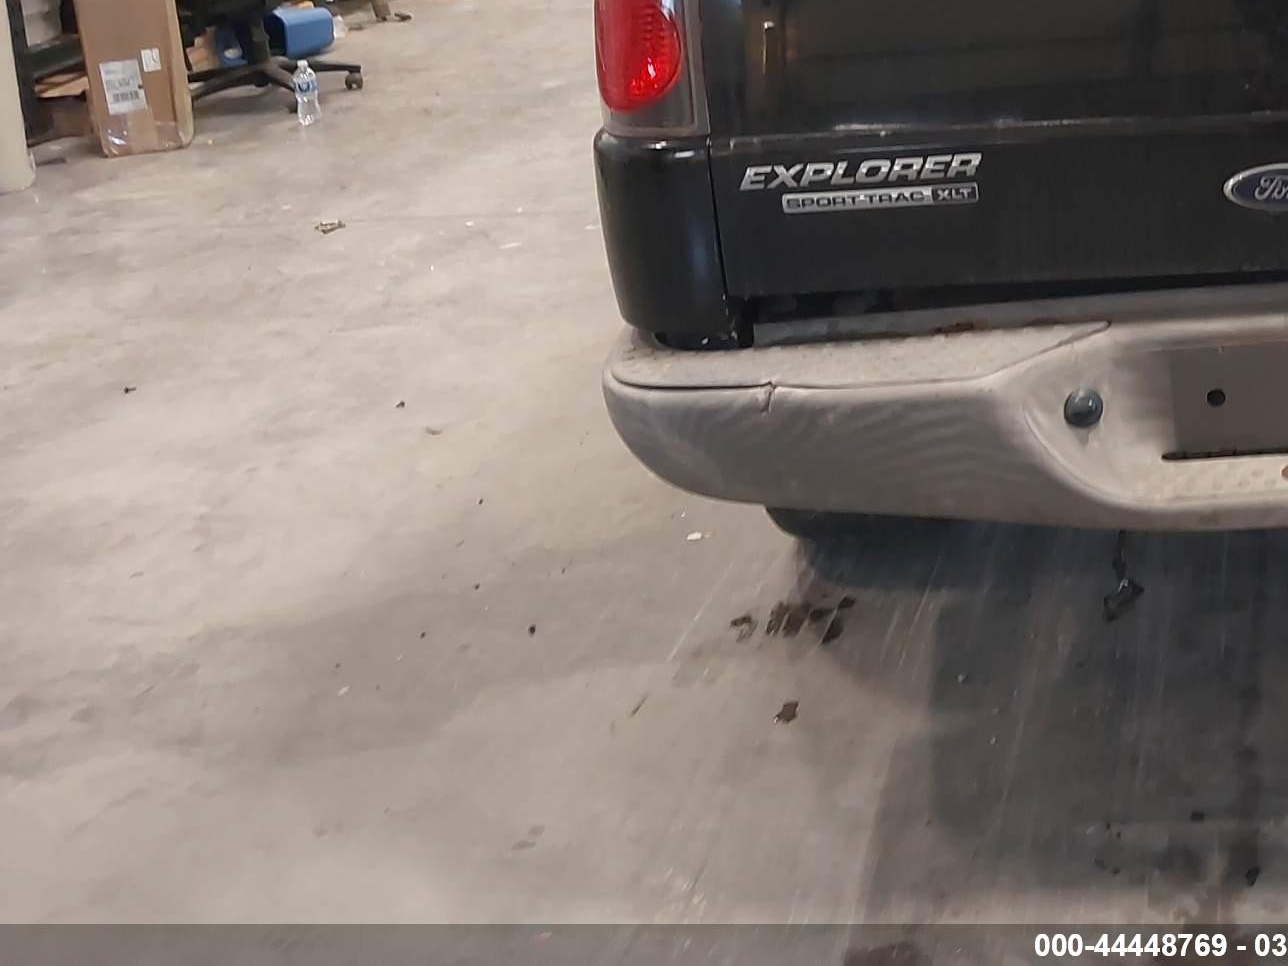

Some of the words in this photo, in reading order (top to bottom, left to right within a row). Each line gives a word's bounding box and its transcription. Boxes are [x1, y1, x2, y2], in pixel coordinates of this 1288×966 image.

[740, 153, 983, 191] EXPLORER
[786, 195, 858, 210] SPORT
[865, 190, 926, 206] TRAC
[935, 186, 974, 202] XLT
